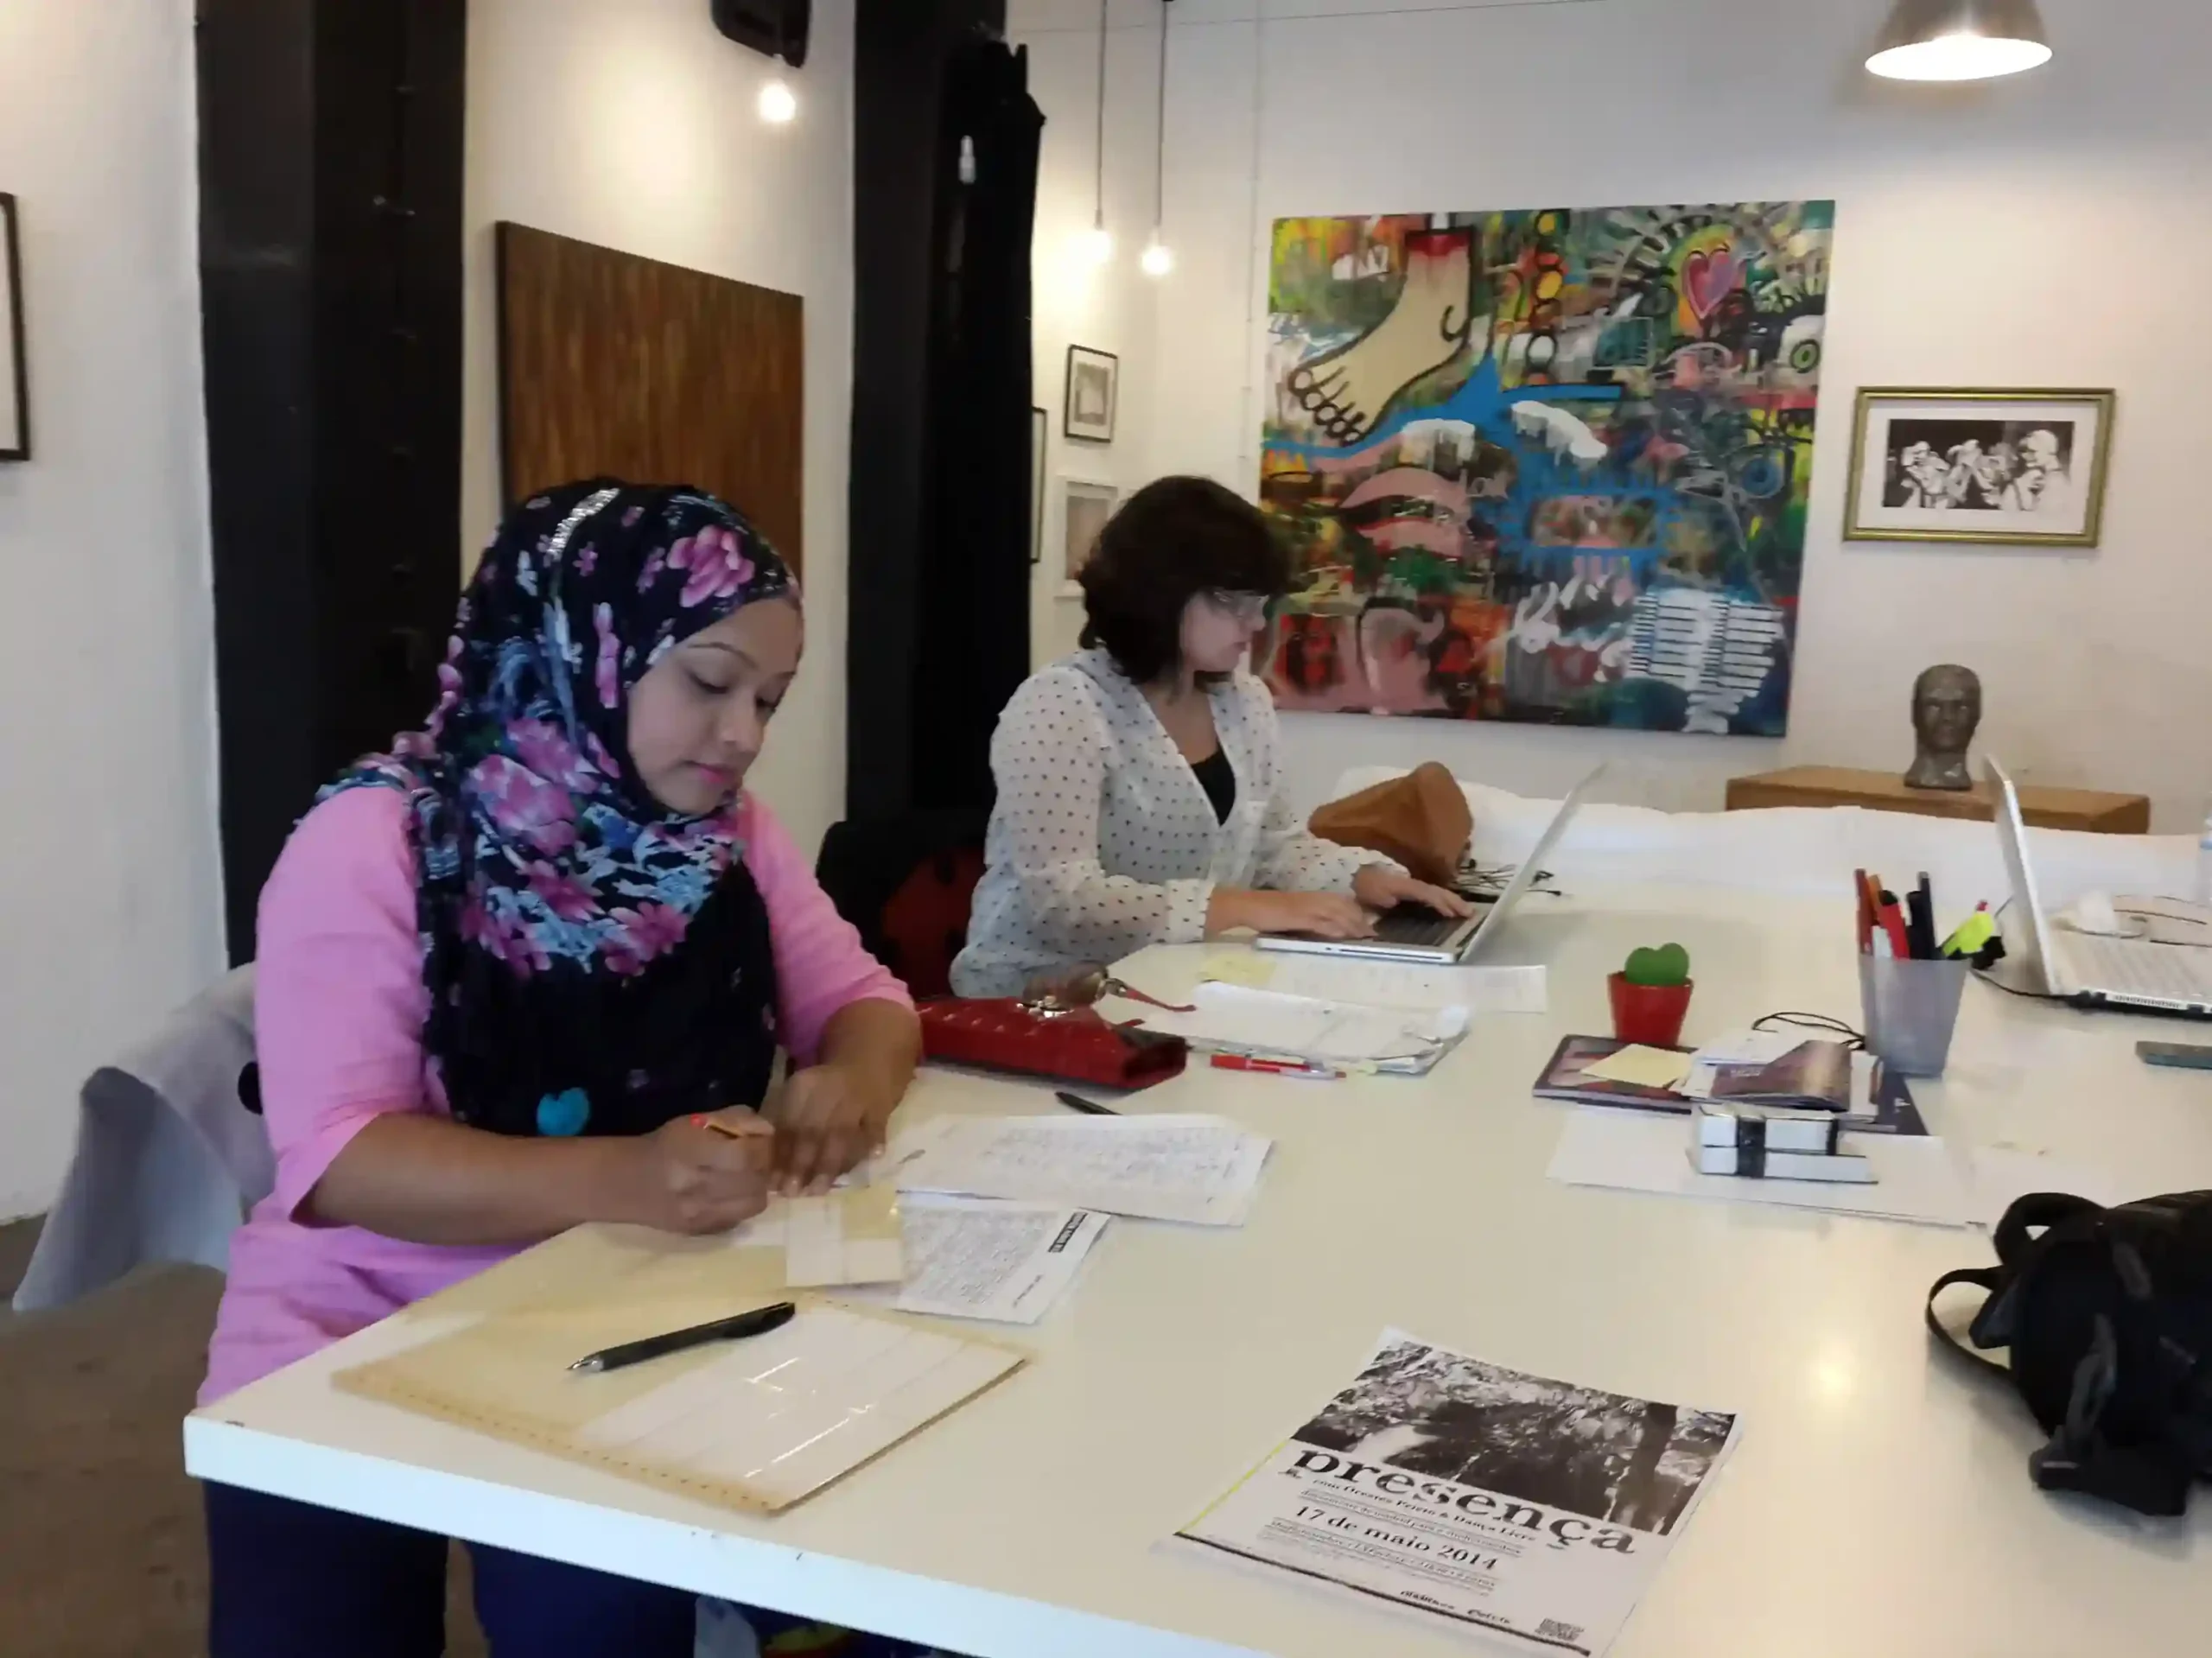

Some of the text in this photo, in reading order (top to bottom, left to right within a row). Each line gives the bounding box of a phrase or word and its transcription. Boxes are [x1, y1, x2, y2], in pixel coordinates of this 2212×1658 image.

[1278, 1449, 1637, 1553] presença
[1296, 1506, 1499, 1570] 17 de maio 2014
